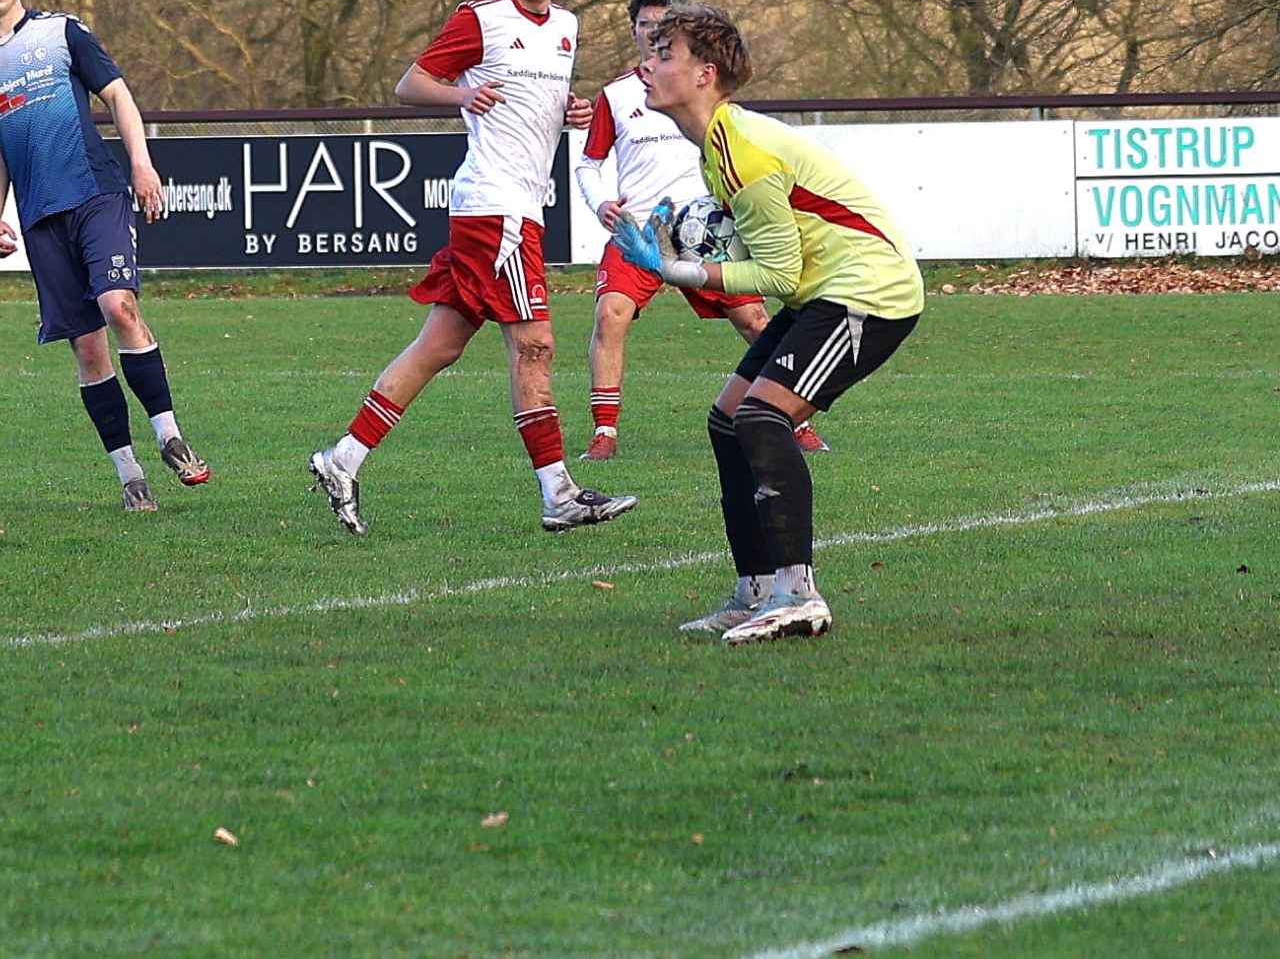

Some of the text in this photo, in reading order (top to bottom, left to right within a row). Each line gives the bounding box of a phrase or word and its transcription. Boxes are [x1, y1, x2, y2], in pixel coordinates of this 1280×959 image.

[1087, 126, 1255, 170] TISTRUP
[243, 141, 417, 230] HAIR
[245, 232, 418, 254] BY BERSANG
[1125, 231, 1198, 250] HENRI
[1215, 230, 1280, 249] JACO
